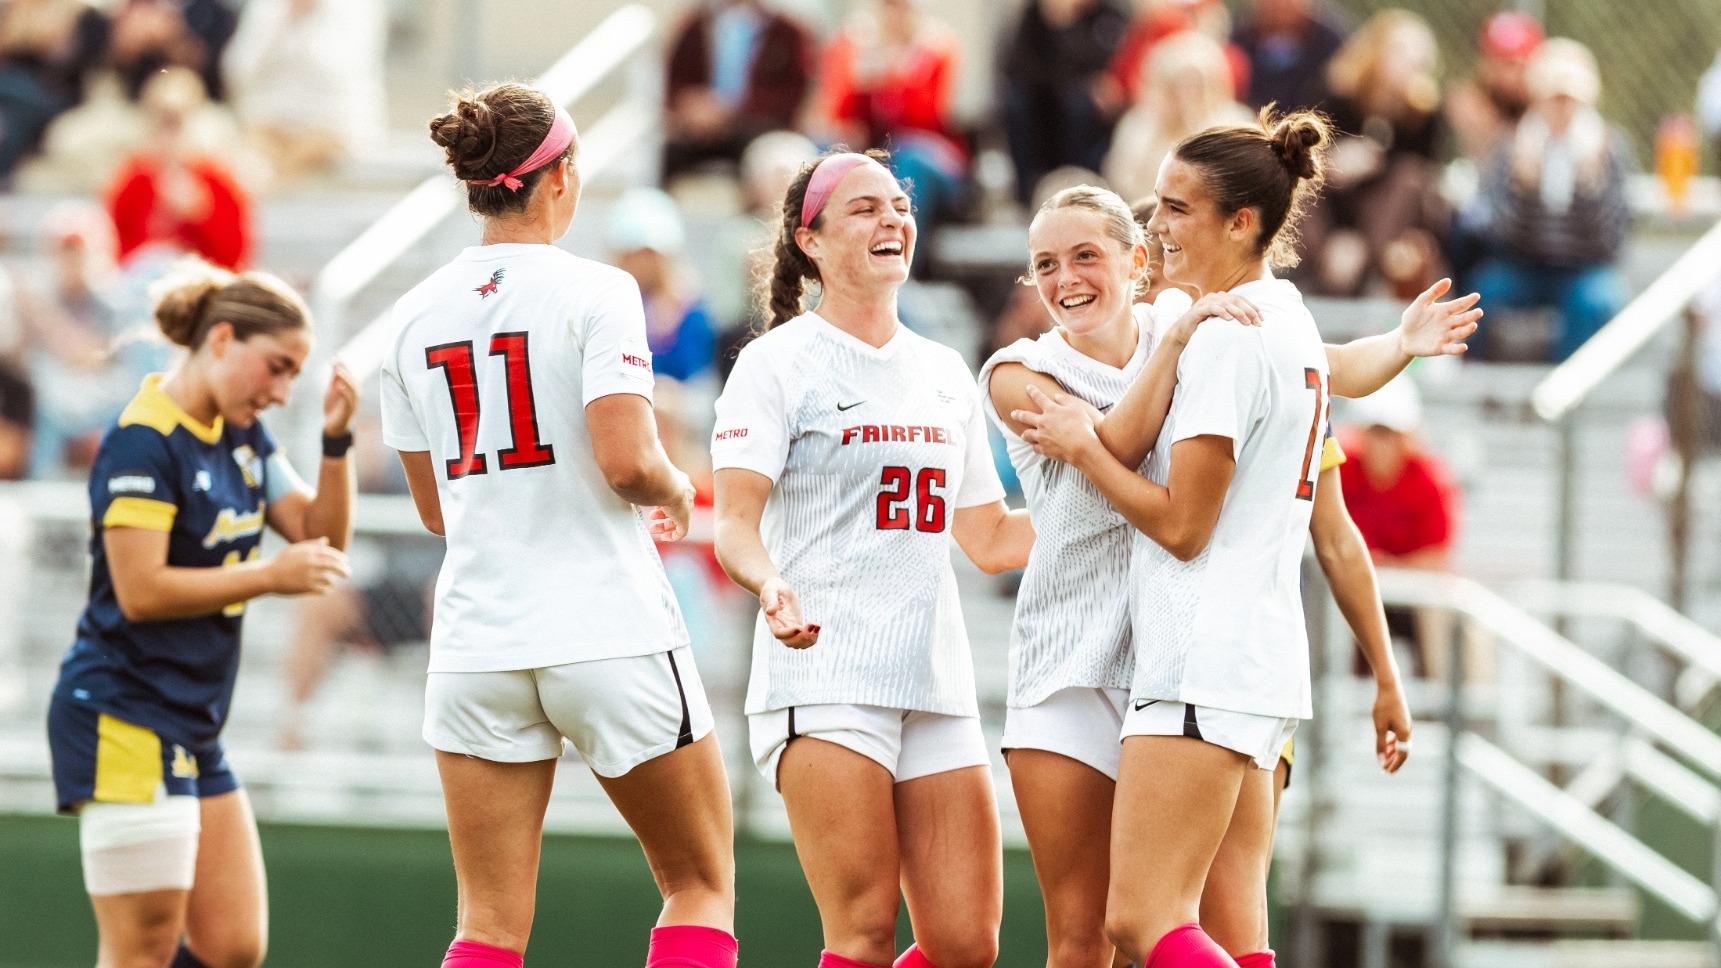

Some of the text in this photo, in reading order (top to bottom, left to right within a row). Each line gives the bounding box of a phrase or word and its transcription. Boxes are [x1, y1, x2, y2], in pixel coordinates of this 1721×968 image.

[425, 331, 556, 481] 11
[715, 428, 748, 441] METRO
[842, 424, 960, 447] FAIRFIEL
[1295, 367, 1331, 502] 1
[876, 466, 946, 533] 26
